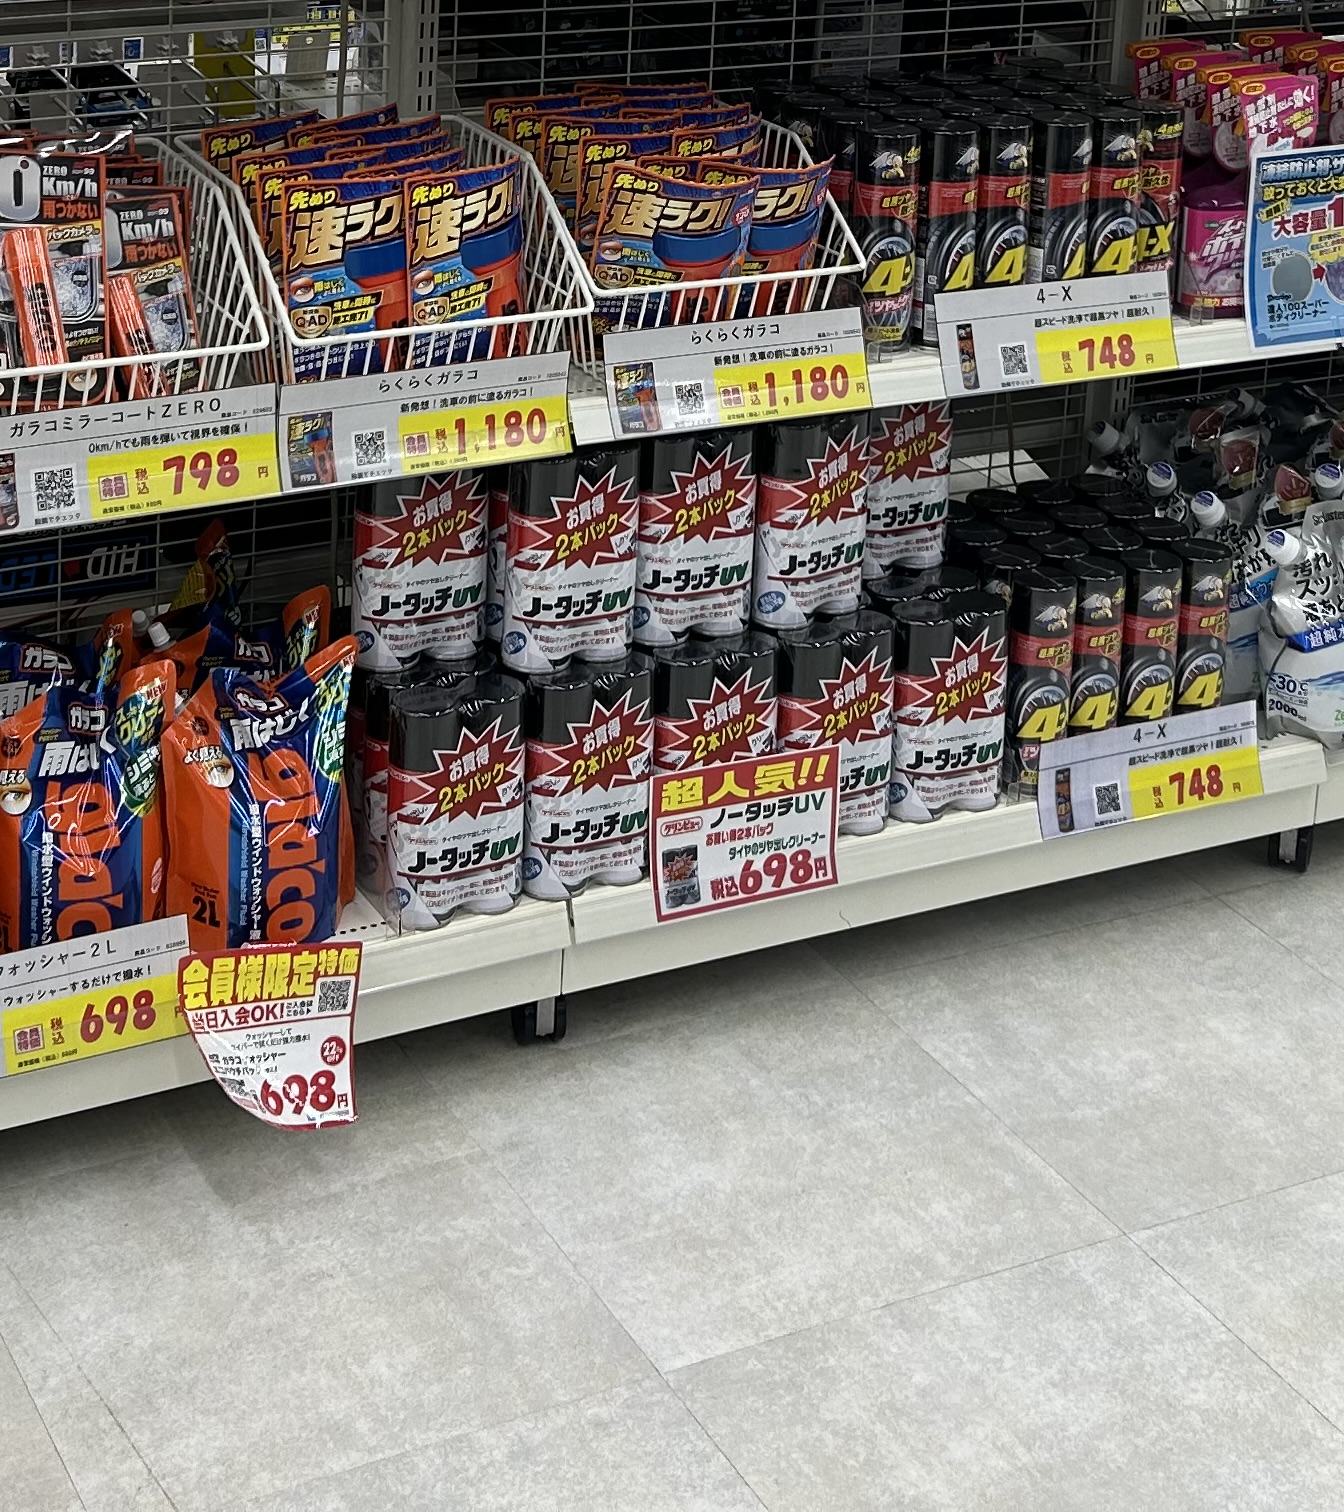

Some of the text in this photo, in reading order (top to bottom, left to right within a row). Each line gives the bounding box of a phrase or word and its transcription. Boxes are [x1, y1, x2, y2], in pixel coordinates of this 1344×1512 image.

[42, 177, 98, 199] Km/h
[288, 188, 336, 210] 先ぬり
[613, 174, 659, 192] 先ぬり
[689, 322, 782, 346] らくらくガラコ
[1078, 333, 1136, 373] 748
[378, 368, 480, 394] らくらくガラコ
[763, 363, 851, 407] 1,180
[10, 396, 222, 439] ガラコミラーコートZERO
[454, 407, 548, 457] 1,180
[162, 448, 241, 496] 798
[402, 510, 470, 558] 2本パック
[554, 512, 620, 560] 2本パック
[372, 580, 486, 619] ノータッチUV
[522, 586, 631, 619] ノータッチUV
[934, 674, 993, 716] 2本パック
[660, 753, 827, 813] 超人気!!
[1168, 764, 1224, 806] 748
[710, 791, 826, 830] ノータッチUV
[408, 833, 520, 874] ノータッチUV
[740, 848, 814, 897] 698
[191, 894, 221, 927] 2L
[183, 947, 360, 1009] 会員様限定特価
[79, 988, 158, 1044] 698
[192, 1003, 285, 1033] 当日入会OK!
[260, 1070, 337, 1117] 698
